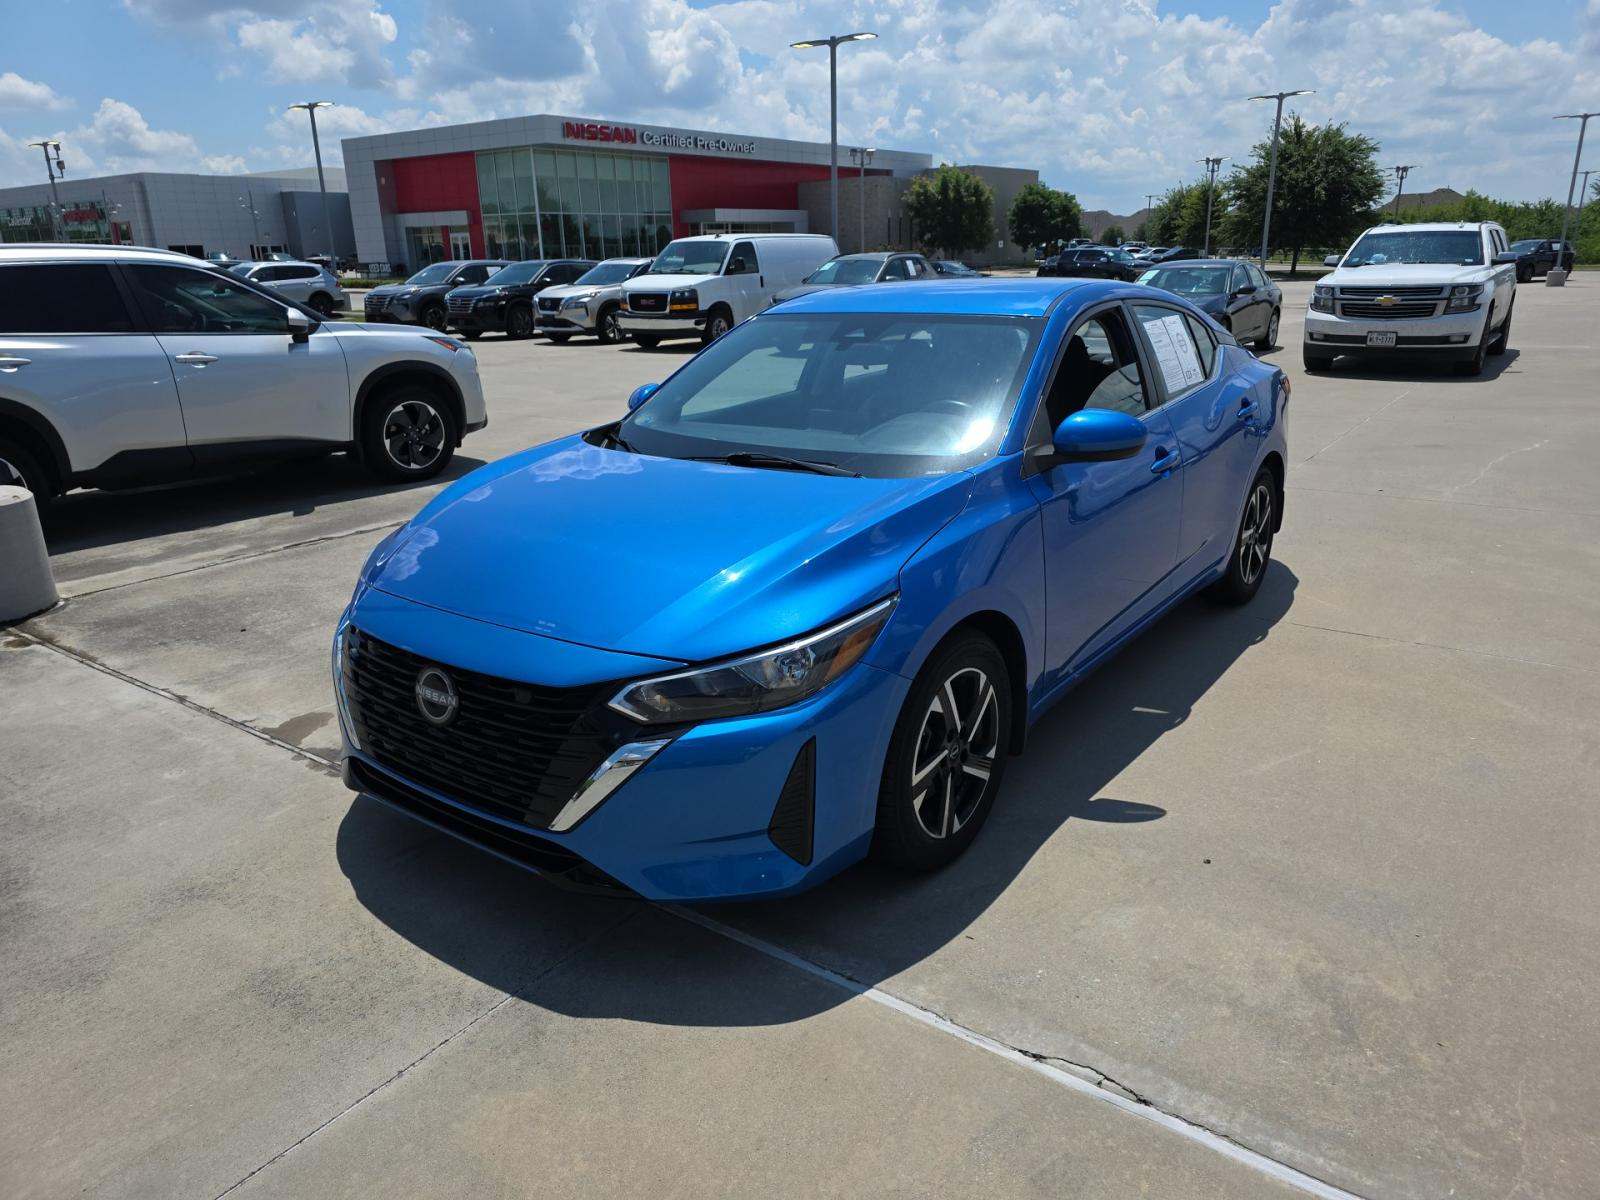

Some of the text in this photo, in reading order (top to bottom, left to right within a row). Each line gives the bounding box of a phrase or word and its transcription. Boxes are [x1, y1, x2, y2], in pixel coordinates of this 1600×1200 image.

[563, 121, 756, 153] NISSAN Certified Pre-Owned
[415, 683, 456, 706] NISSAN
